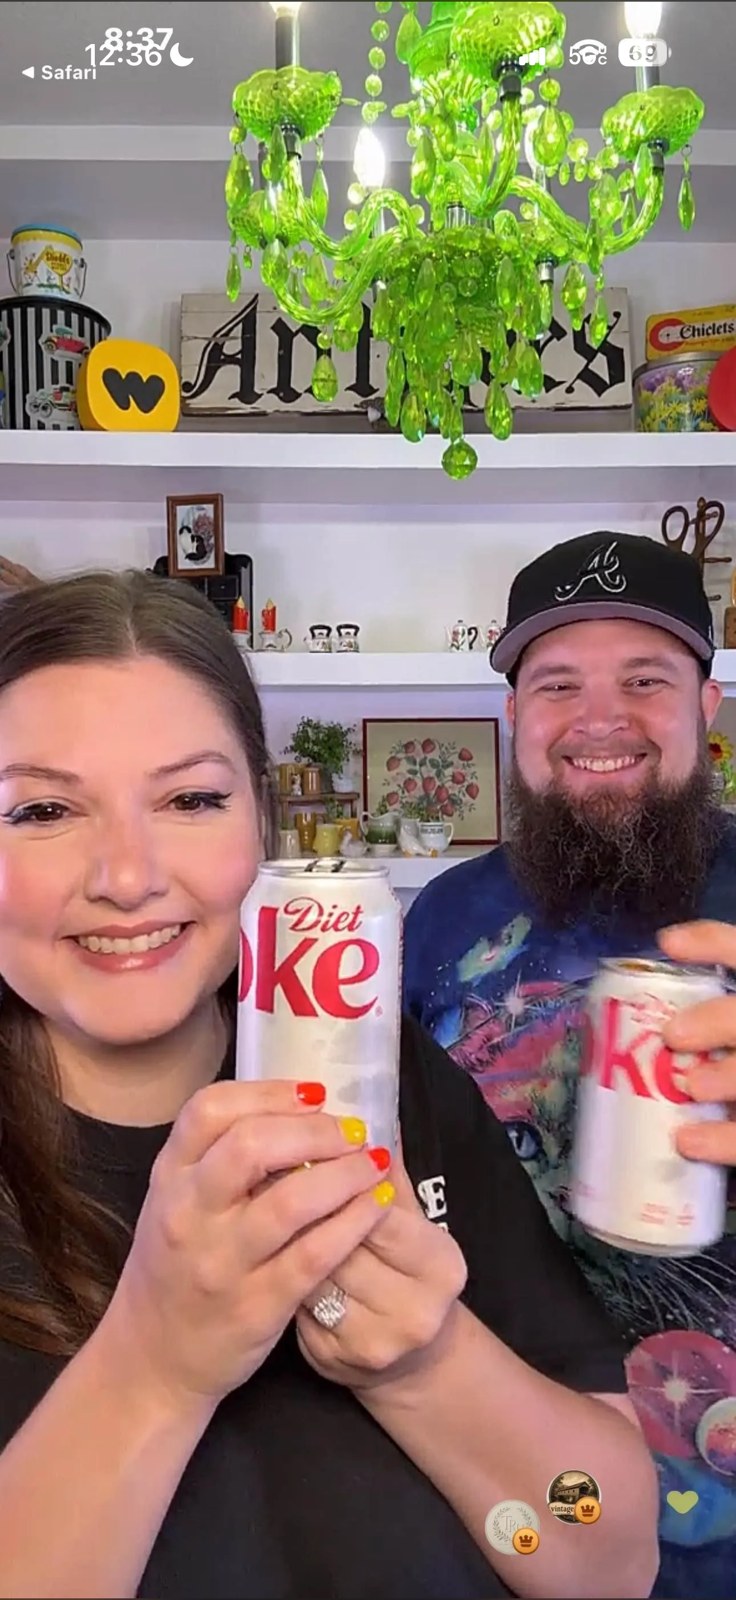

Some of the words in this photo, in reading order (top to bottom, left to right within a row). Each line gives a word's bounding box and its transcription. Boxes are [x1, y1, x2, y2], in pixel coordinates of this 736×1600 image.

[182, 293, 626, 406] Ants
[680, 322, 735, 339] Chiclets
[284, 896, 363, 933] Diet
[239, 906, 380, 1019] ke
